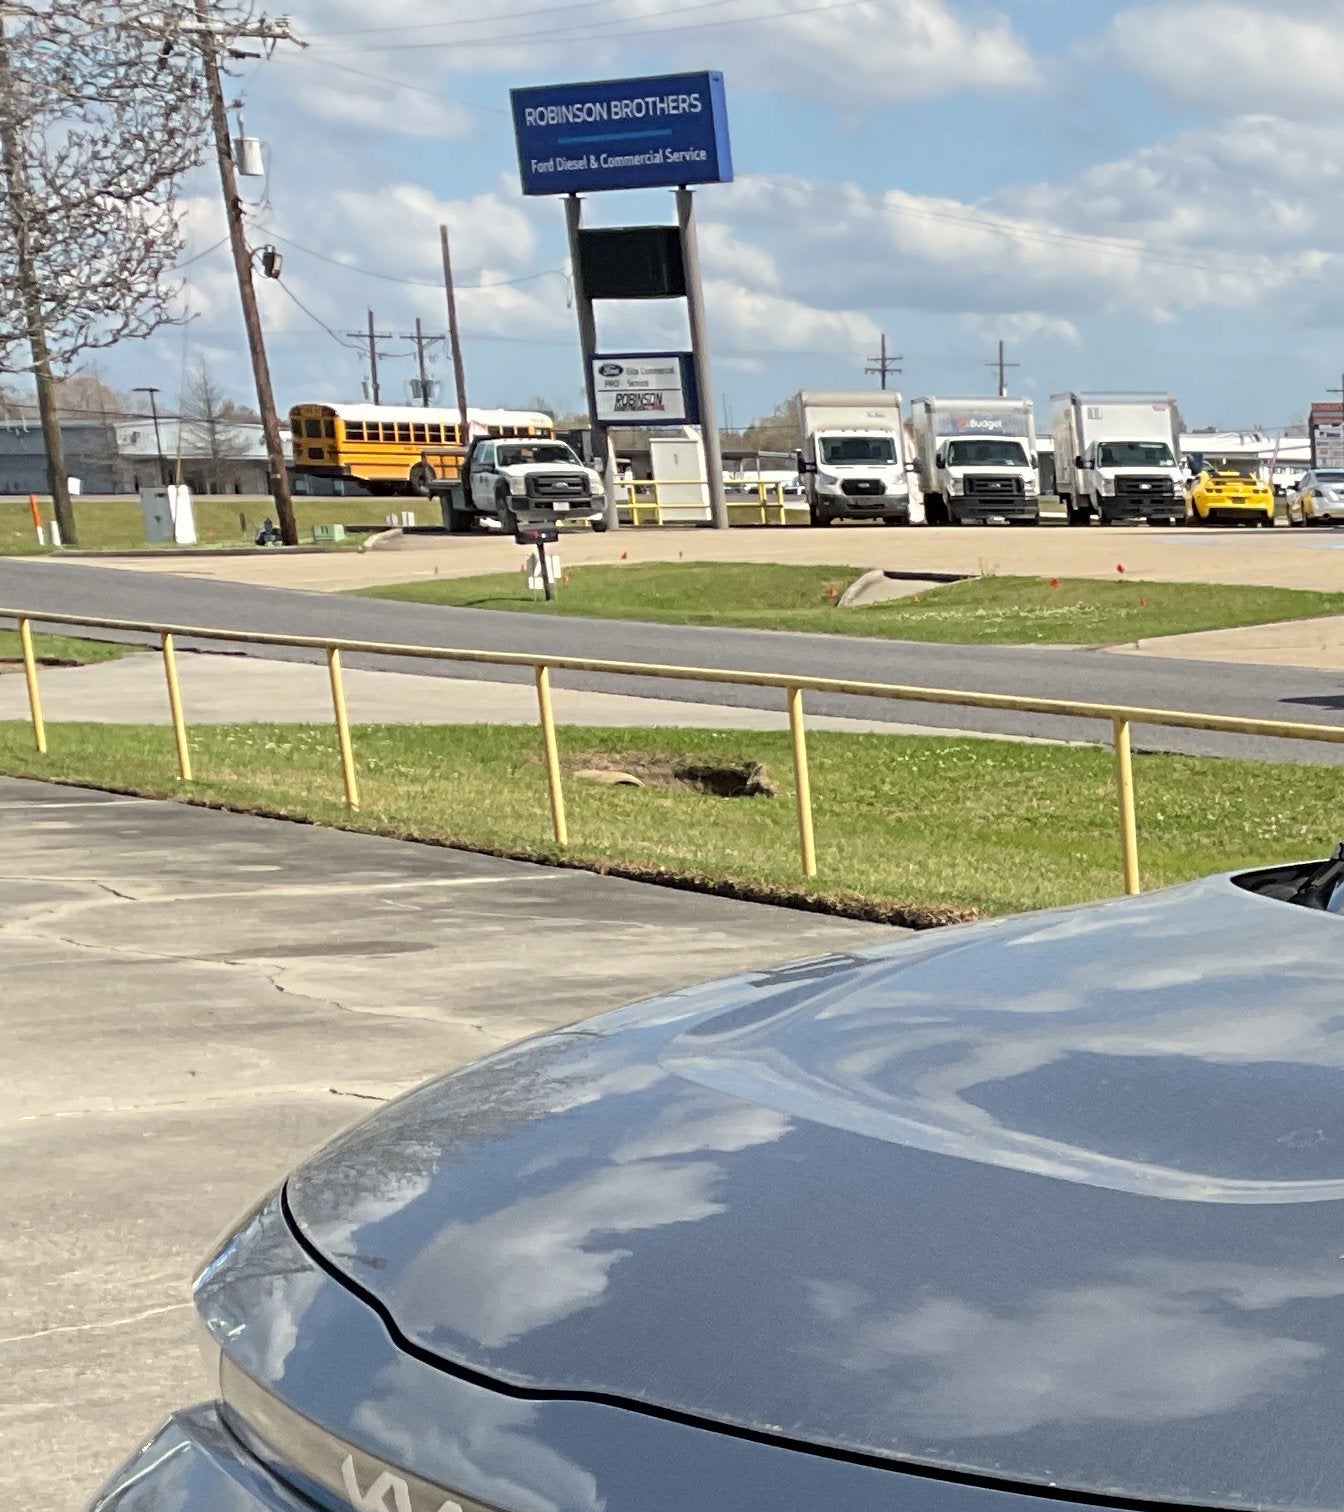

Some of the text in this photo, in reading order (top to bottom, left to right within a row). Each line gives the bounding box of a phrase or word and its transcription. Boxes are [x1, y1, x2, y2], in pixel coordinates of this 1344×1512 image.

[525, 93, 702, 126] ROBINSON BROTHERS
[531, 146, 707, 174] Ford Diesel & Commercial Service
[969, 418, 1003, 430] Budget
